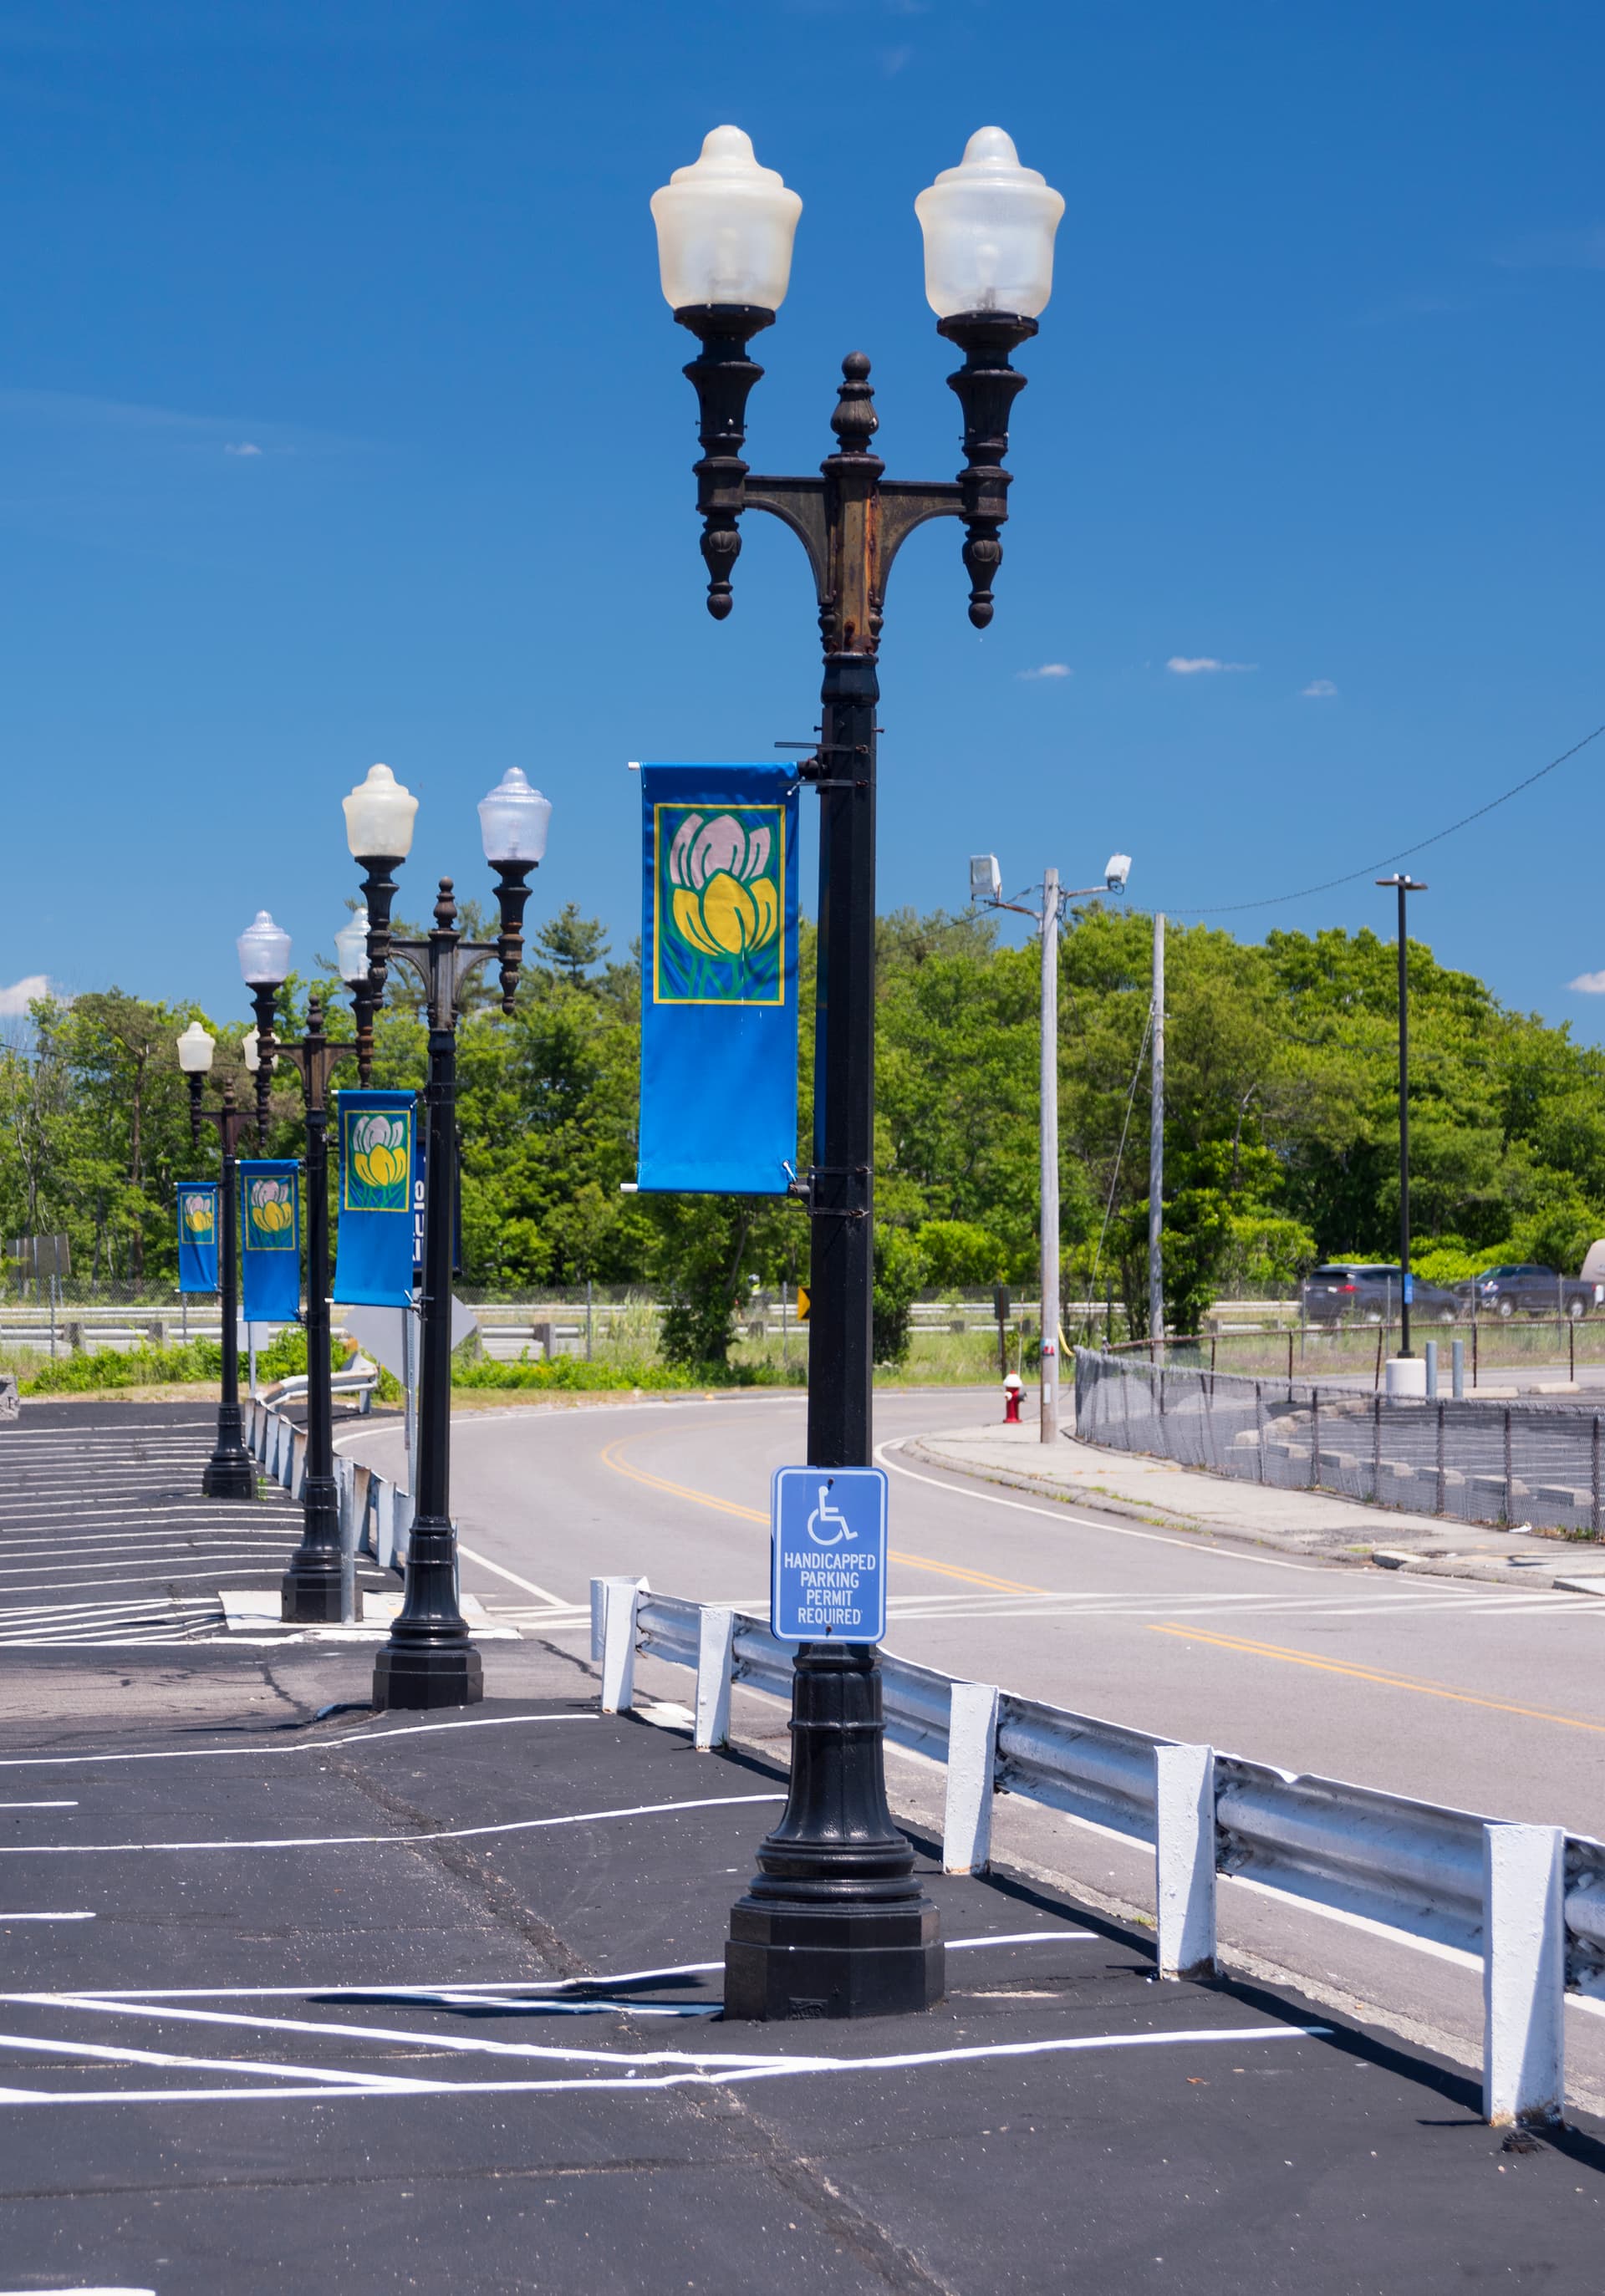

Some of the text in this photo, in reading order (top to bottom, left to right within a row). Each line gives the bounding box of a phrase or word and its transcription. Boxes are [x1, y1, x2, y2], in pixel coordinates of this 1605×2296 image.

[784, 1552, 876, 1571] HANDICAPPED
[800, 1571, 859, 1588] PARKING
[806, 1589, 853, 1606] PERMIT
[797, 1607, 861, 1625] REQUIRED
